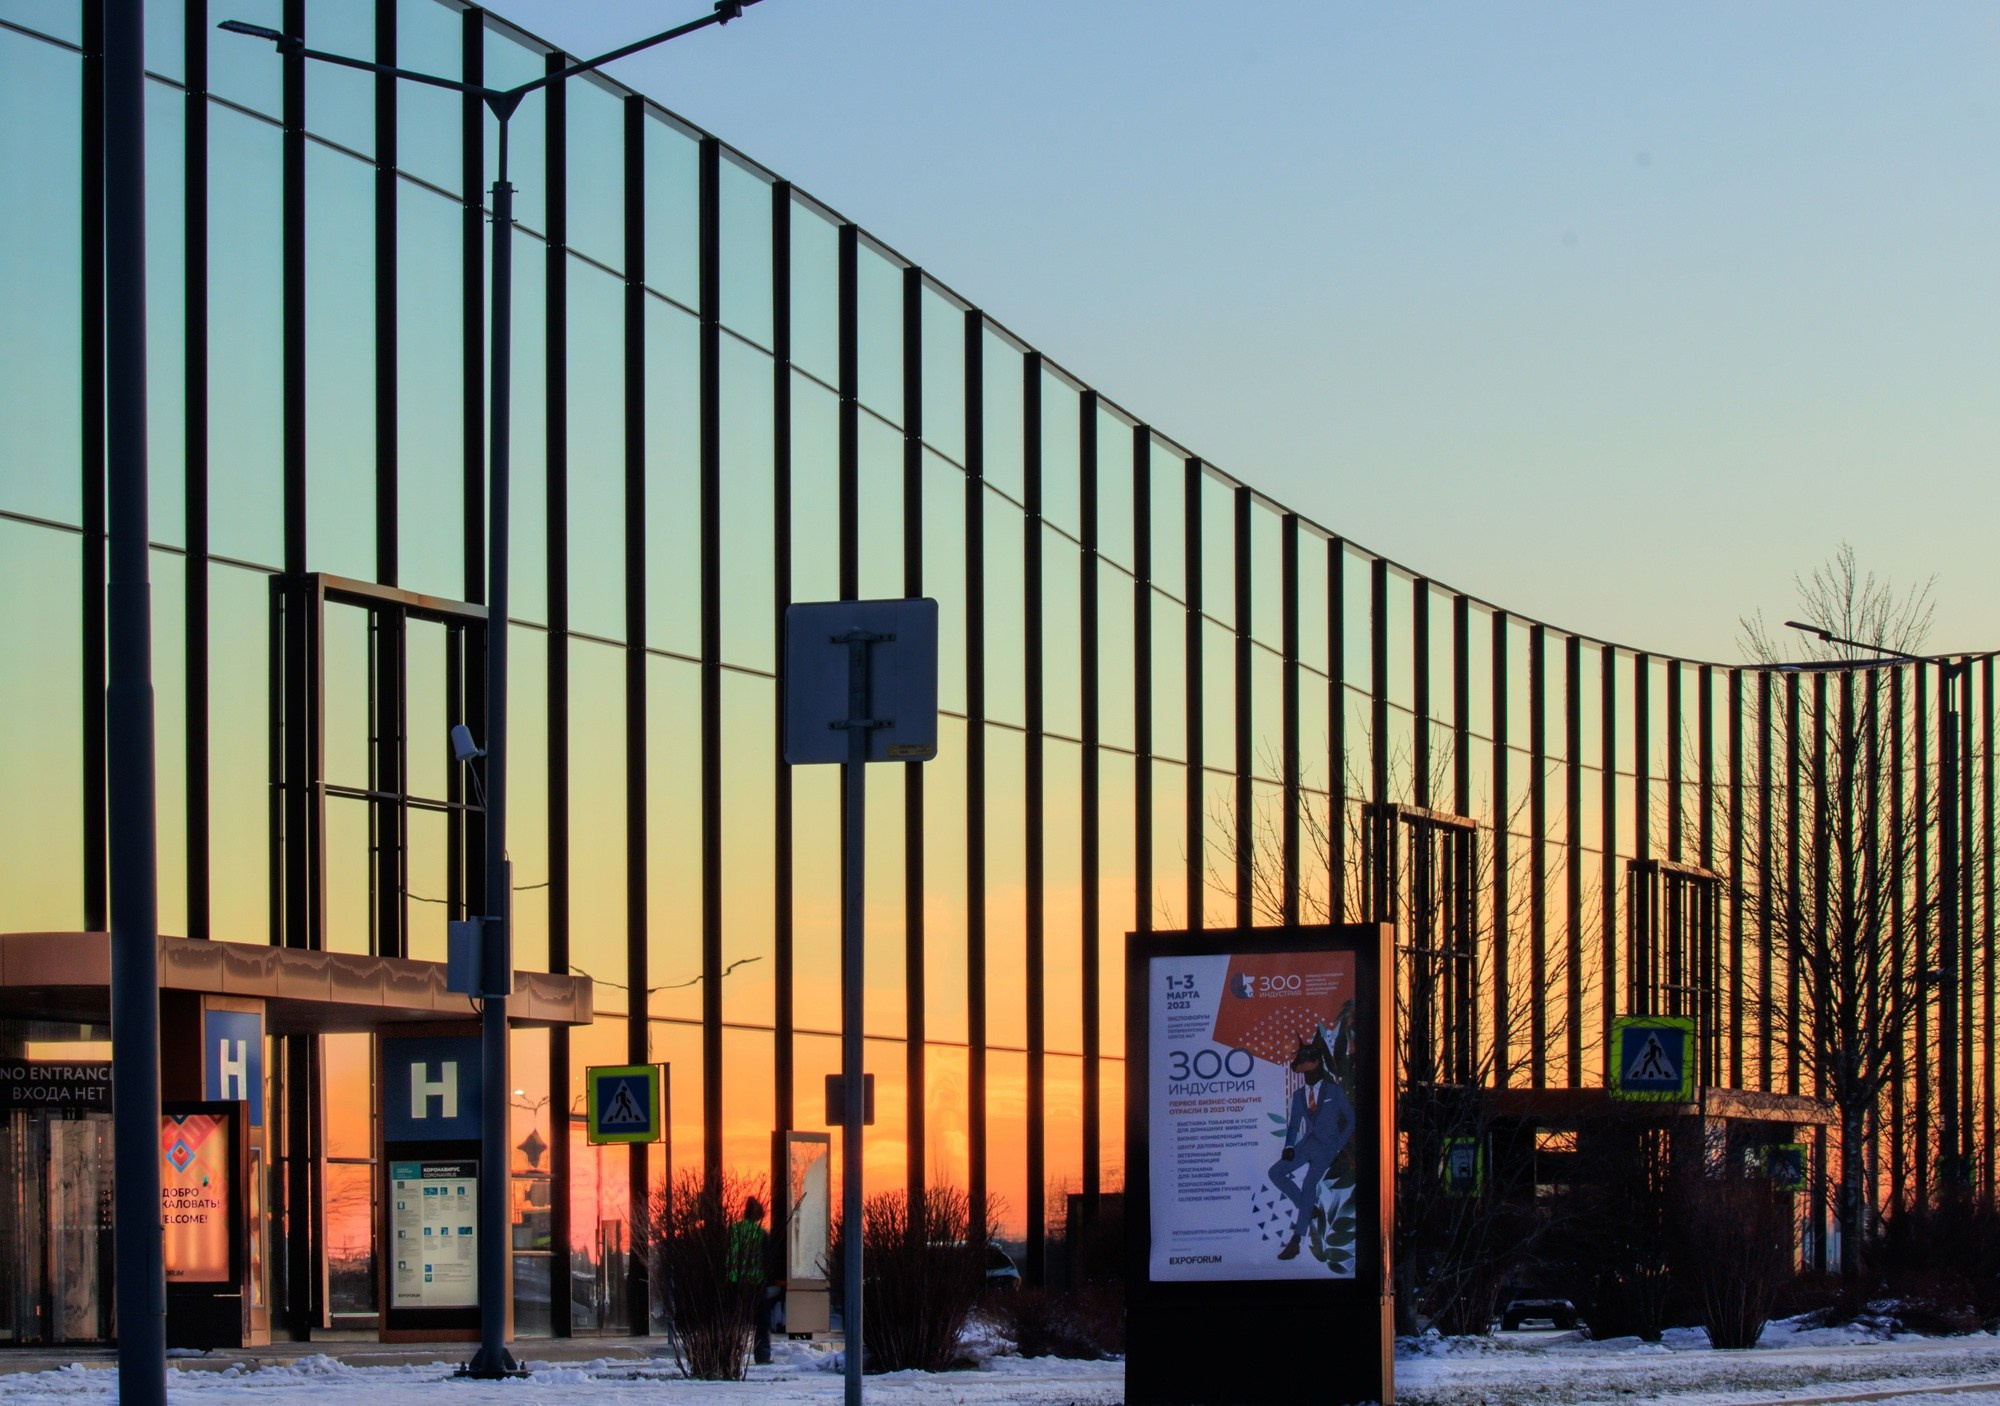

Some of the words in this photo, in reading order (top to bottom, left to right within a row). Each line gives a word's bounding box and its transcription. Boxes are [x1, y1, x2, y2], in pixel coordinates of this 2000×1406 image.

[1166, 974, 1194, 990] 1-3
[1260, 974, 1301, 991] ЗОО
[1167, 991, 1200, 1000] МАРТА
[1260, 990, 1302, 998] ИНДУСТРИЯ
[1167, 1001, 1191, 1010] 2023
[1168, 1014, 1210, 1022] ЭКСПОФОРУМ
[1169, 1048, 1254, 1081] ЗОО
[0, 1067, 26, 1080] NO
[1169, 1080, 1255, 1096] ИНДУСТРИЯ
[13, 1087, 70, 1101] ВХОДА
[75, 1087, 106, 1100] НЕТ
[1198, 1097, 1262, 1105] БИЗНЕС-СОБЫТИЕ
[1169, 1107, 1202, 1115] ОТРАСЛИ
[163, 1188, 199, 1198] ДОБРО
[163, 1214, 208, 1224] ELCOME!
[1169, 1255, 1222, 1265] EXPOFORUM
